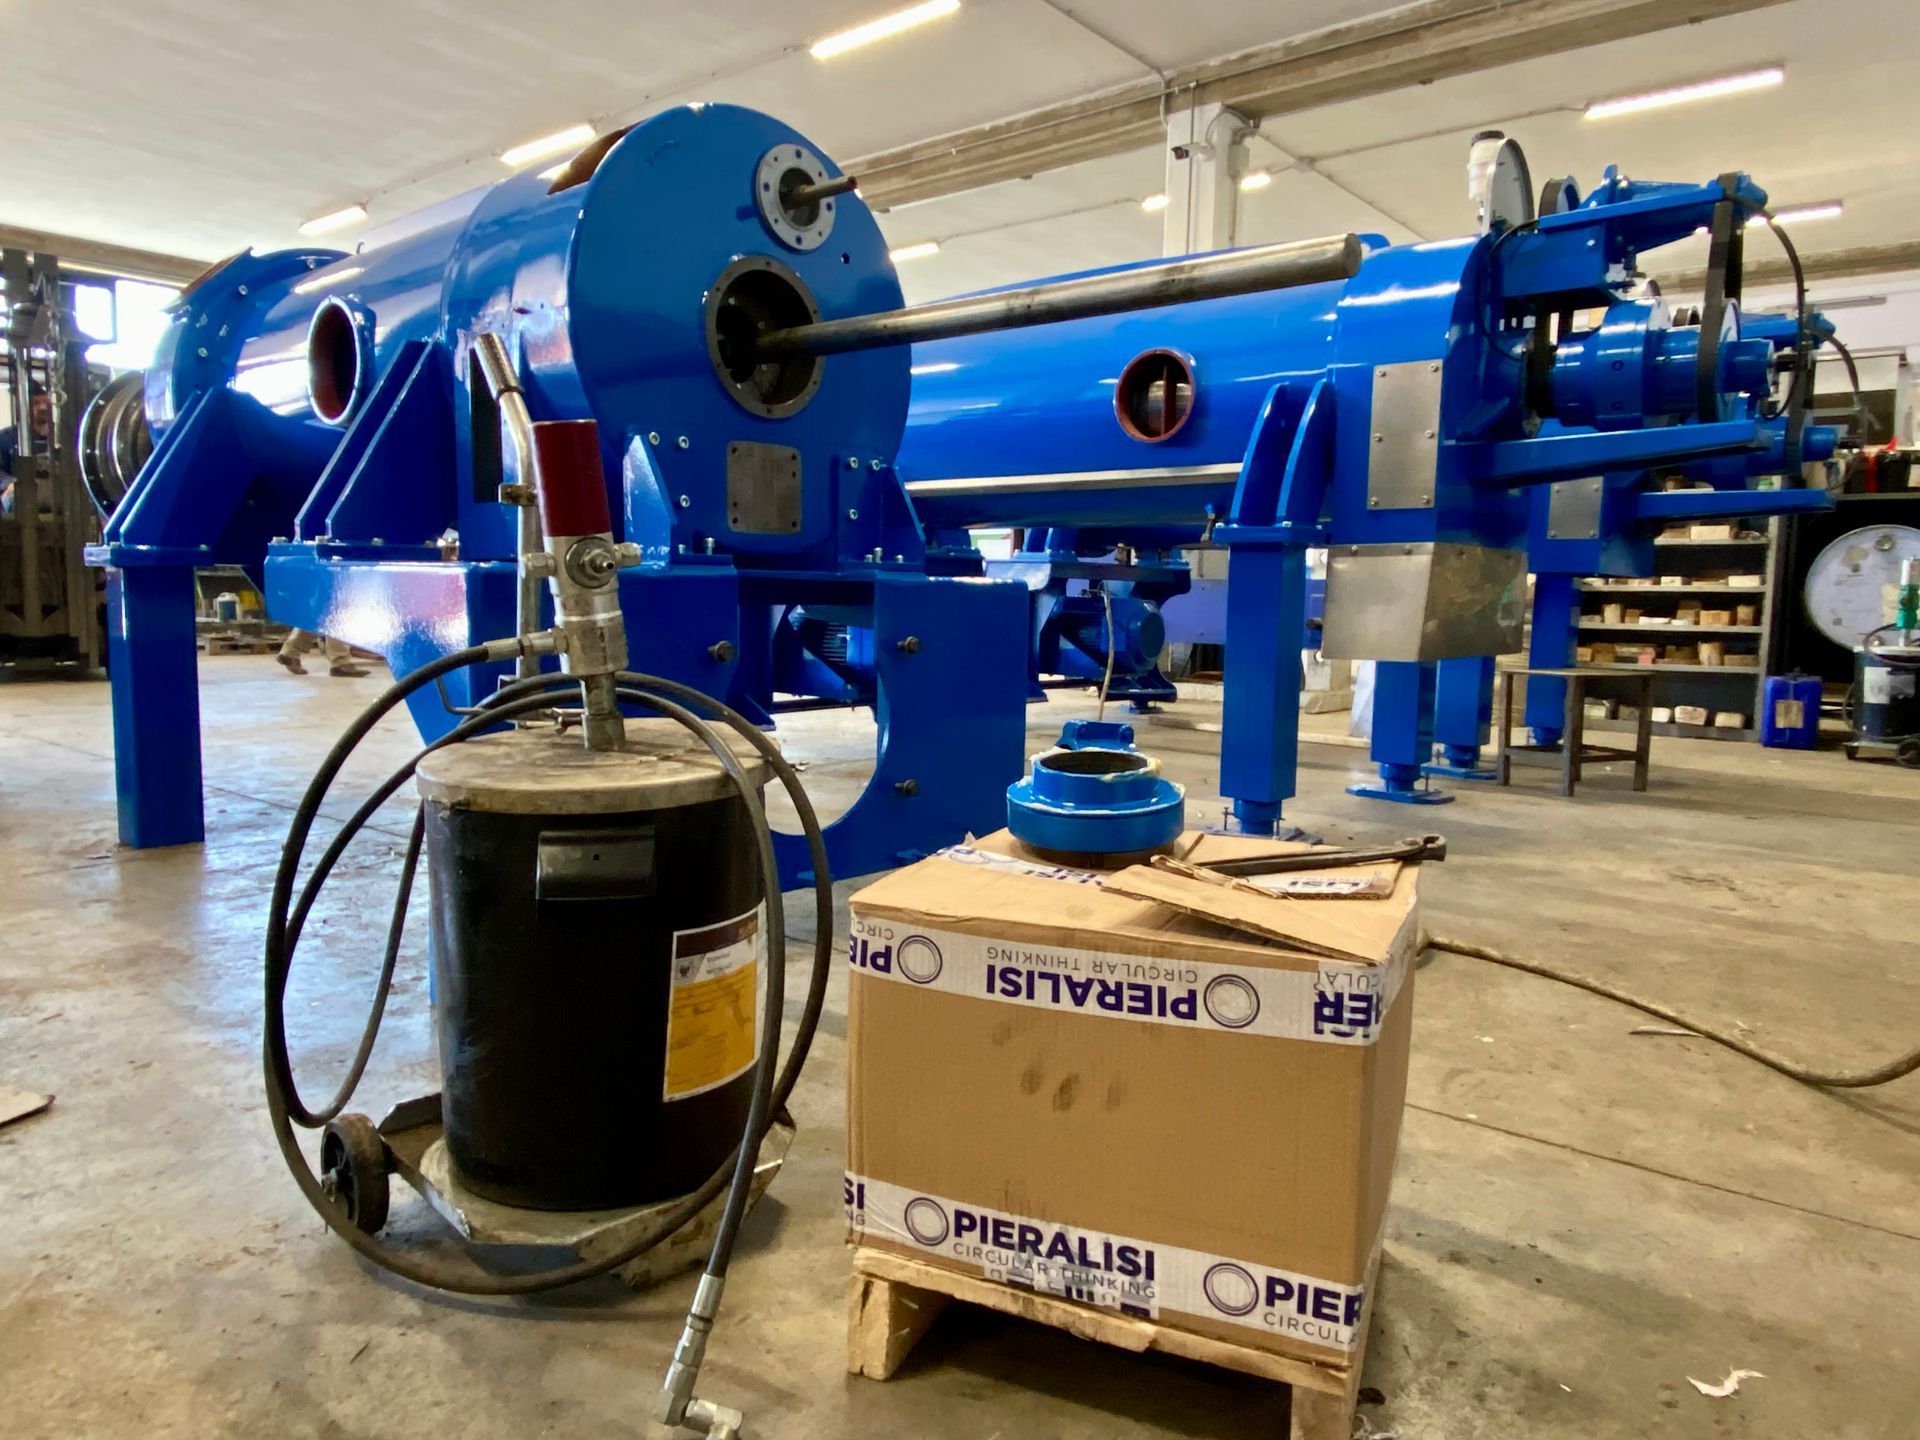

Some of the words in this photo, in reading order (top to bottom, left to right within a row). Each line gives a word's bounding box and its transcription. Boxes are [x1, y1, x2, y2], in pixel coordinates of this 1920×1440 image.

[987, 947, 1079, 971] THINKING
[1093, 960, 1198, 983] CIRCULAR
[986, 964, 1198, 1021] PIERALISI
[953, 1242, 1048, 1276] CIRCULAR
[1060, 1266, 1156, 1298] THINKING
[954, 1209, 1155, 1281] PIERALISI
